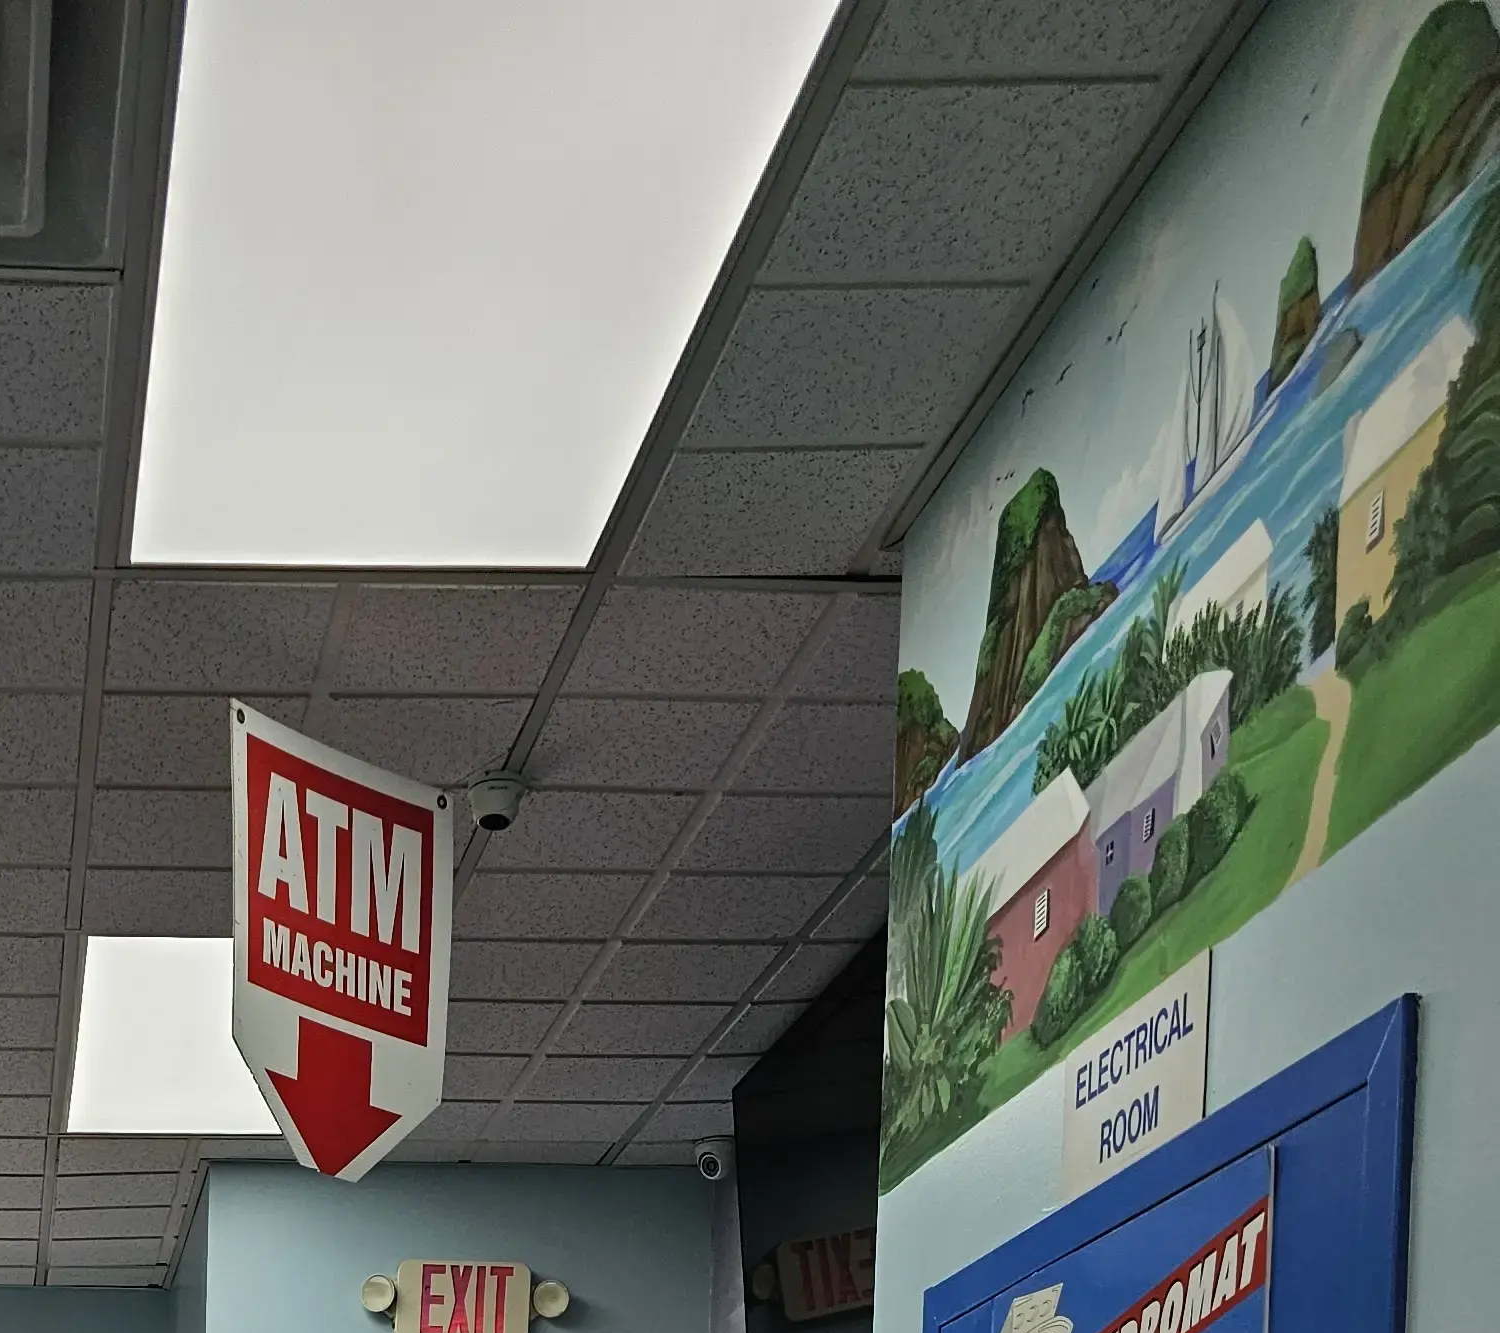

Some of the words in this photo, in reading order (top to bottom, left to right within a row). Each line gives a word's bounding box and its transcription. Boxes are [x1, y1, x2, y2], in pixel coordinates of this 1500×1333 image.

[258, 772, 423, 955] ATM
[262, 917, 412, 1017] MACHINE
[1076, 992, 1193, 1110] ELECTRICAL
[1099, 1085, 1159, 1164] ROOM
